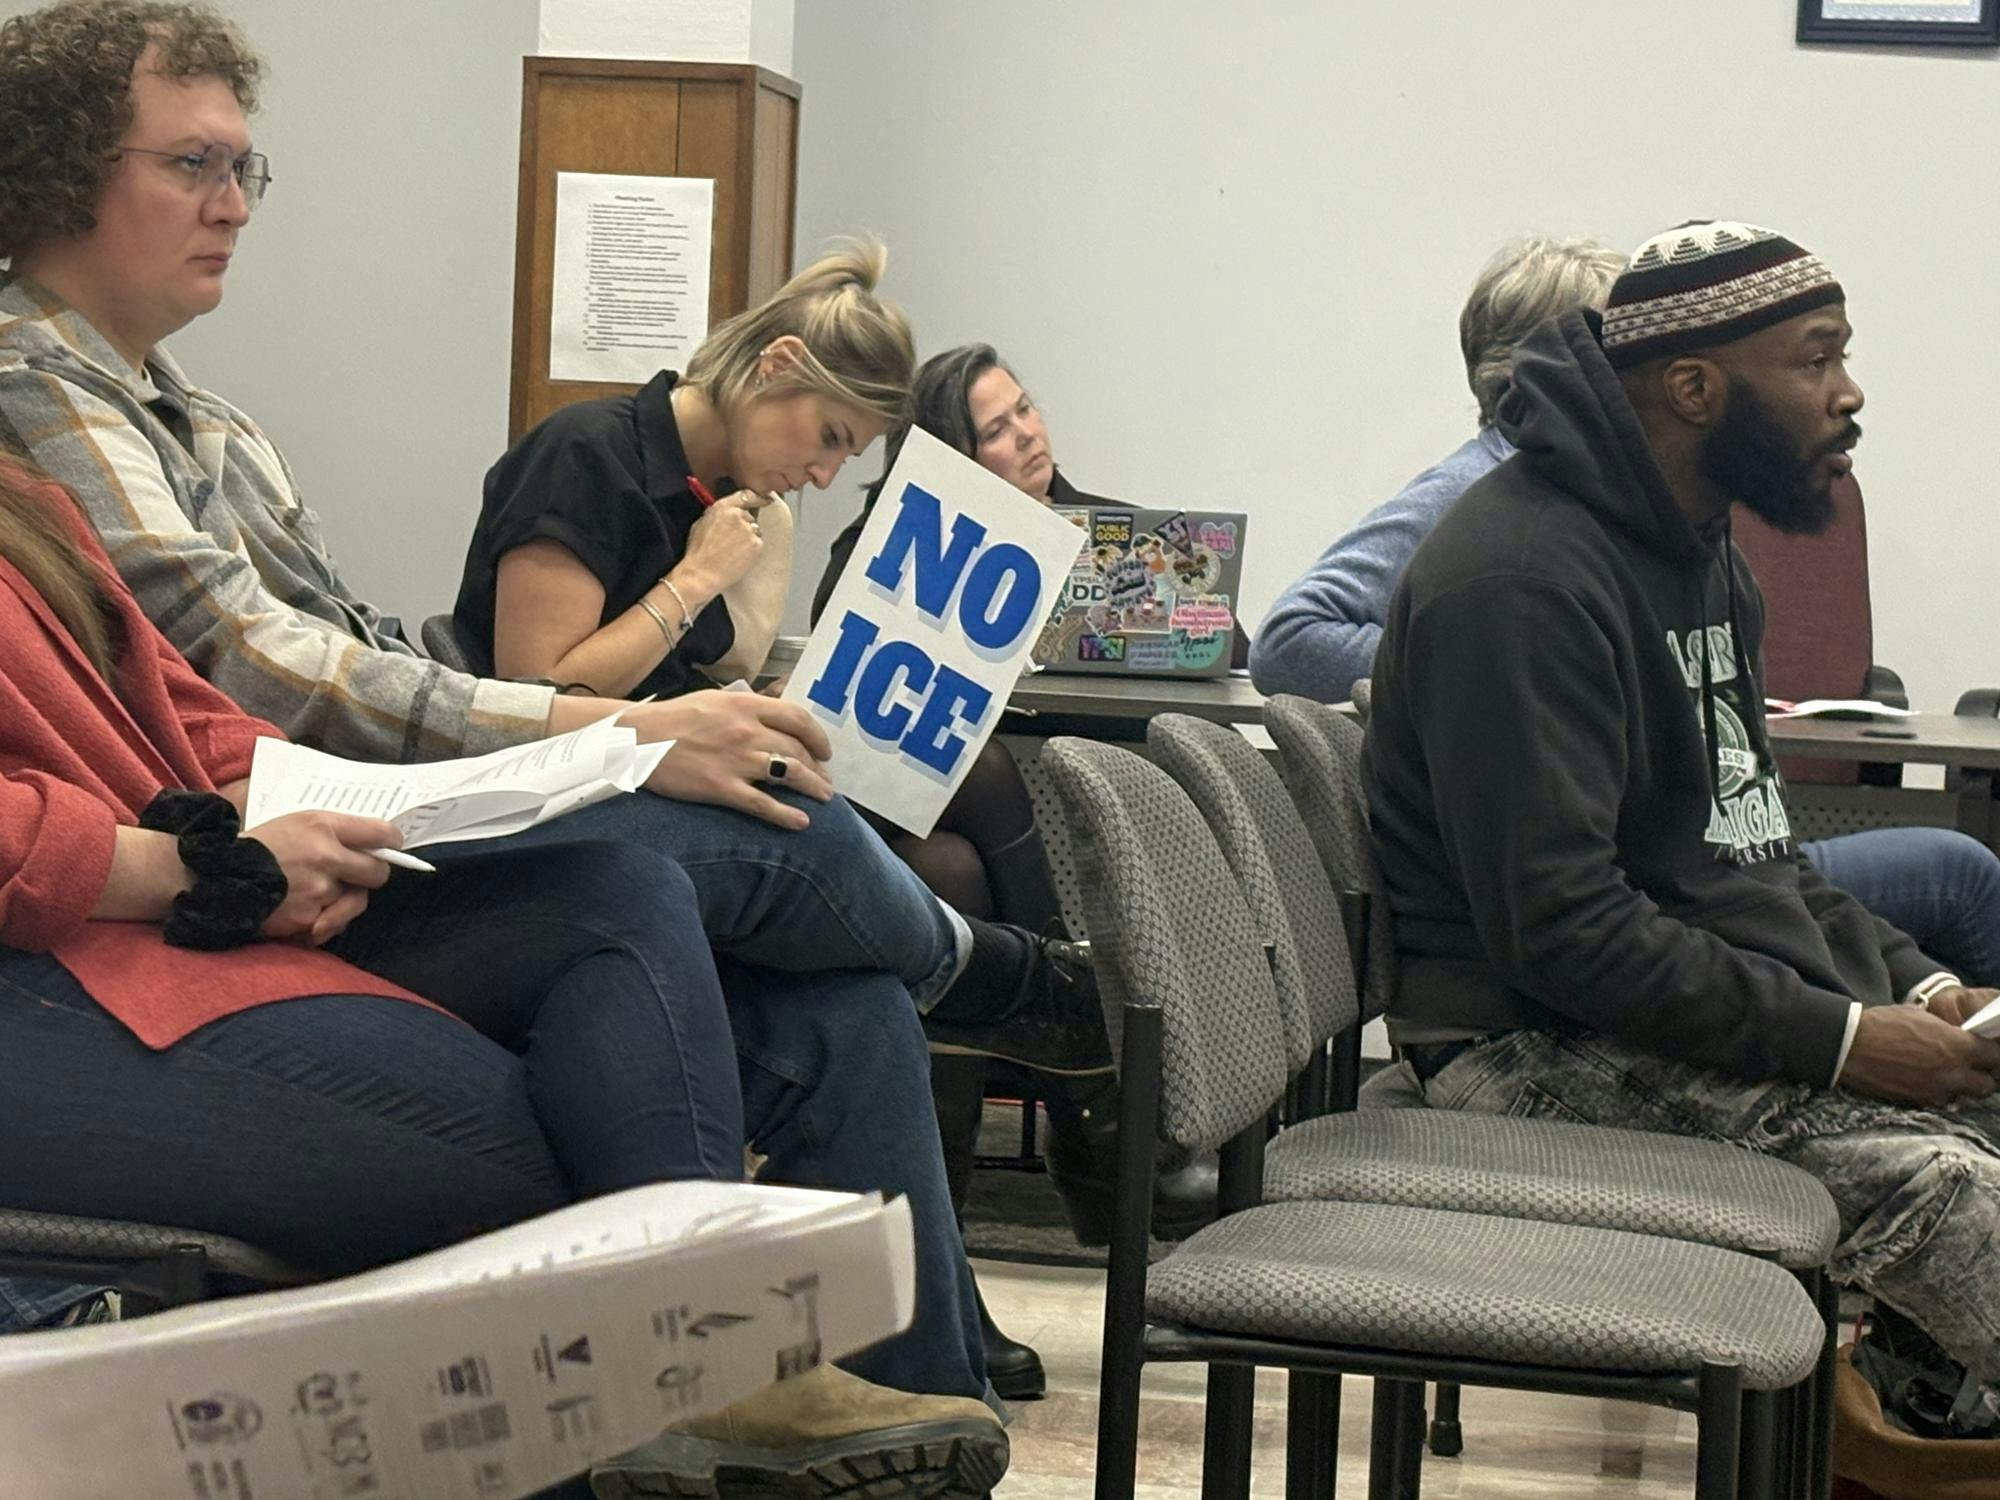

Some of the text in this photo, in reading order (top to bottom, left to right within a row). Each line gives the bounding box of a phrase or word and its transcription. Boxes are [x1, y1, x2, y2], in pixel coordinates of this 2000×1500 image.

[1096, 524, 1130, 534] PUBLIC
[1096, 532, 1130, 542] GOOD
[865, 482, 1042, 650] NO
[1073, 576, 1104, 584] YPSIL
[1072, 584, 1107, 601] DD
[807, 609, 993, 776] ICE
